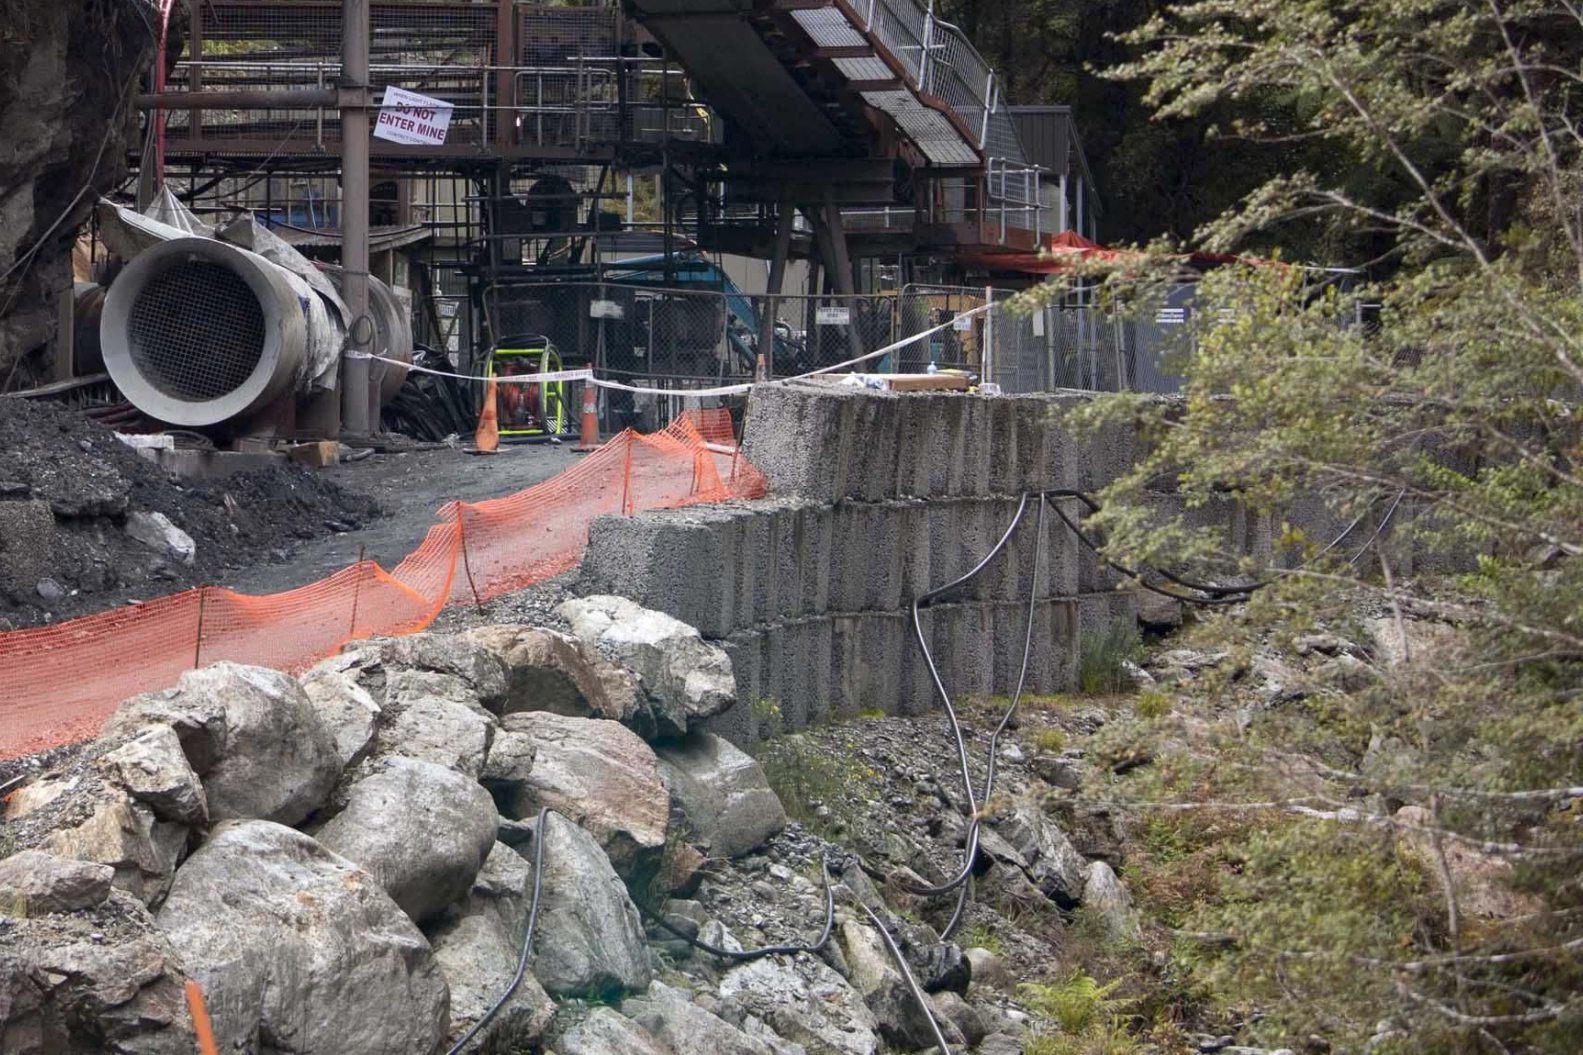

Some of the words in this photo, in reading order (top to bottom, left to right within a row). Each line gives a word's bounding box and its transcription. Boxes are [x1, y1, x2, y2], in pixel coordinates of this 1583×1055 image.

[395, 101, 410, 114] DO
[413, 106, 437, 122] NOT
[379, 112, 415, 132] ENTER
[416, 124, 446, 141] MINE
